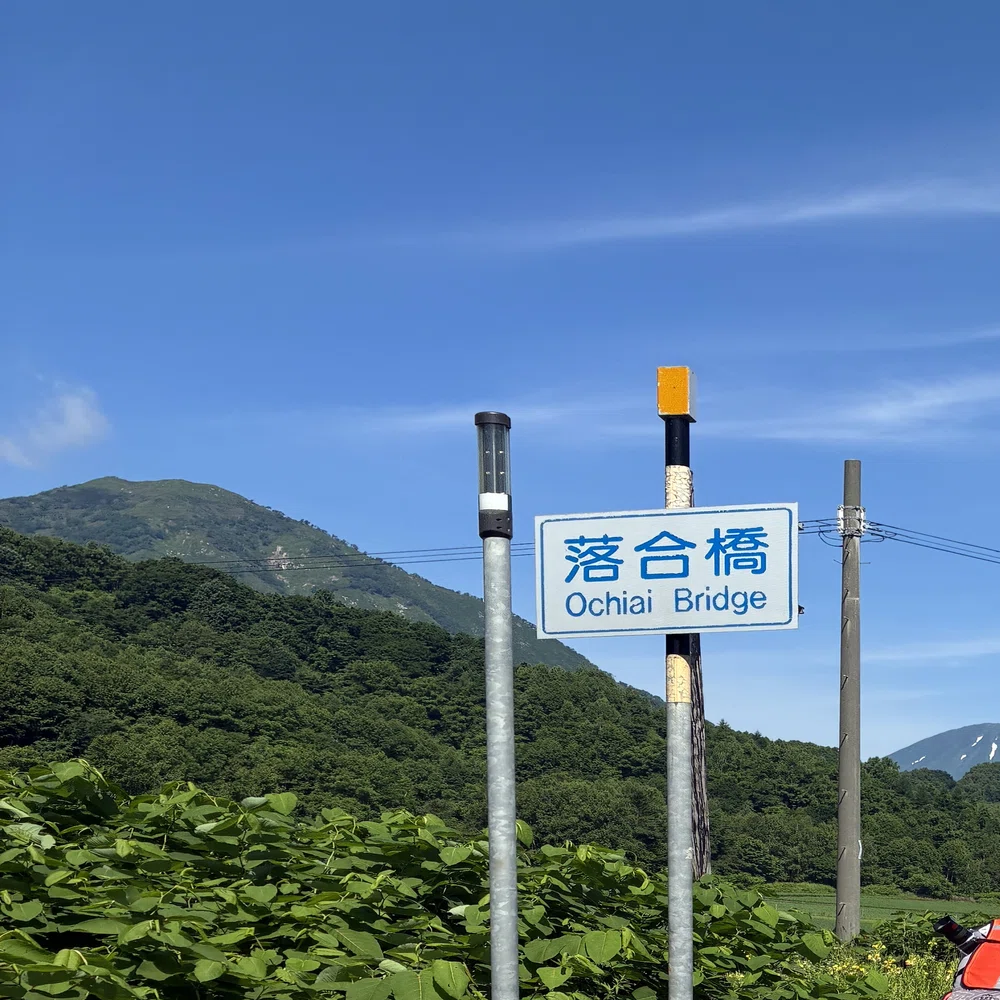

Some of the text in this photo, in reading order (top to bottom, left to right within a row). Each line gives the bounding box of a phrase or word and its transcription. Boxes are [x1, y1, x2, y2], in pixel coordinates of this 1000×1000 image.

[564, 526, 769, 584] 落合橋
[565, 585, 767, 617] Ochiai Bridge
